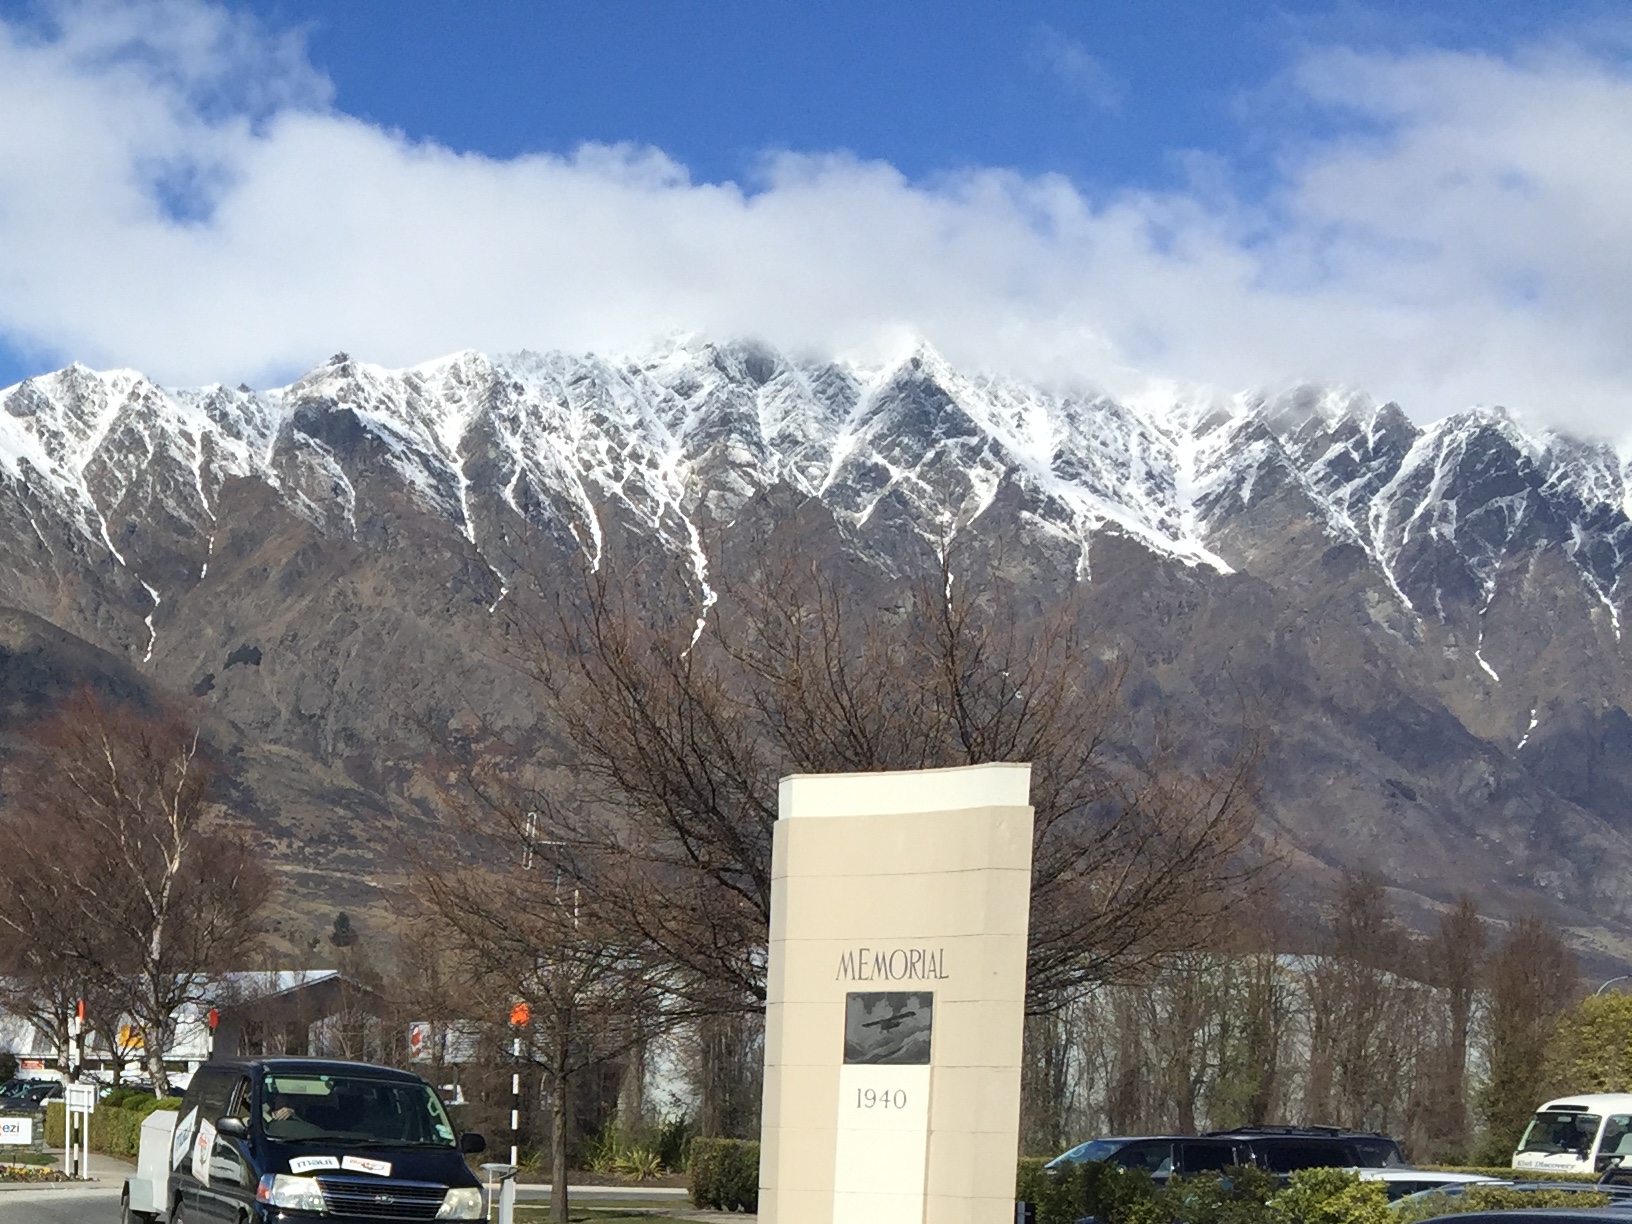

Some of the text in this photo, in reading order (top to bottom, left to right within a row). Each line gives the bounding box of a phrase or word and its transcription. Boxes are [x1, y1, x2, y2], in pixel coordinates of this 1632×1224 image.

[835, 948, 949, 981] MEMORIAL
[856, 1088, 907, 1110] 1940
[2, 1121, 20, 1133] ezi
[296, 1158, 333, 1168] maui
[1534, 1160, 1576, 1169] Discovery
